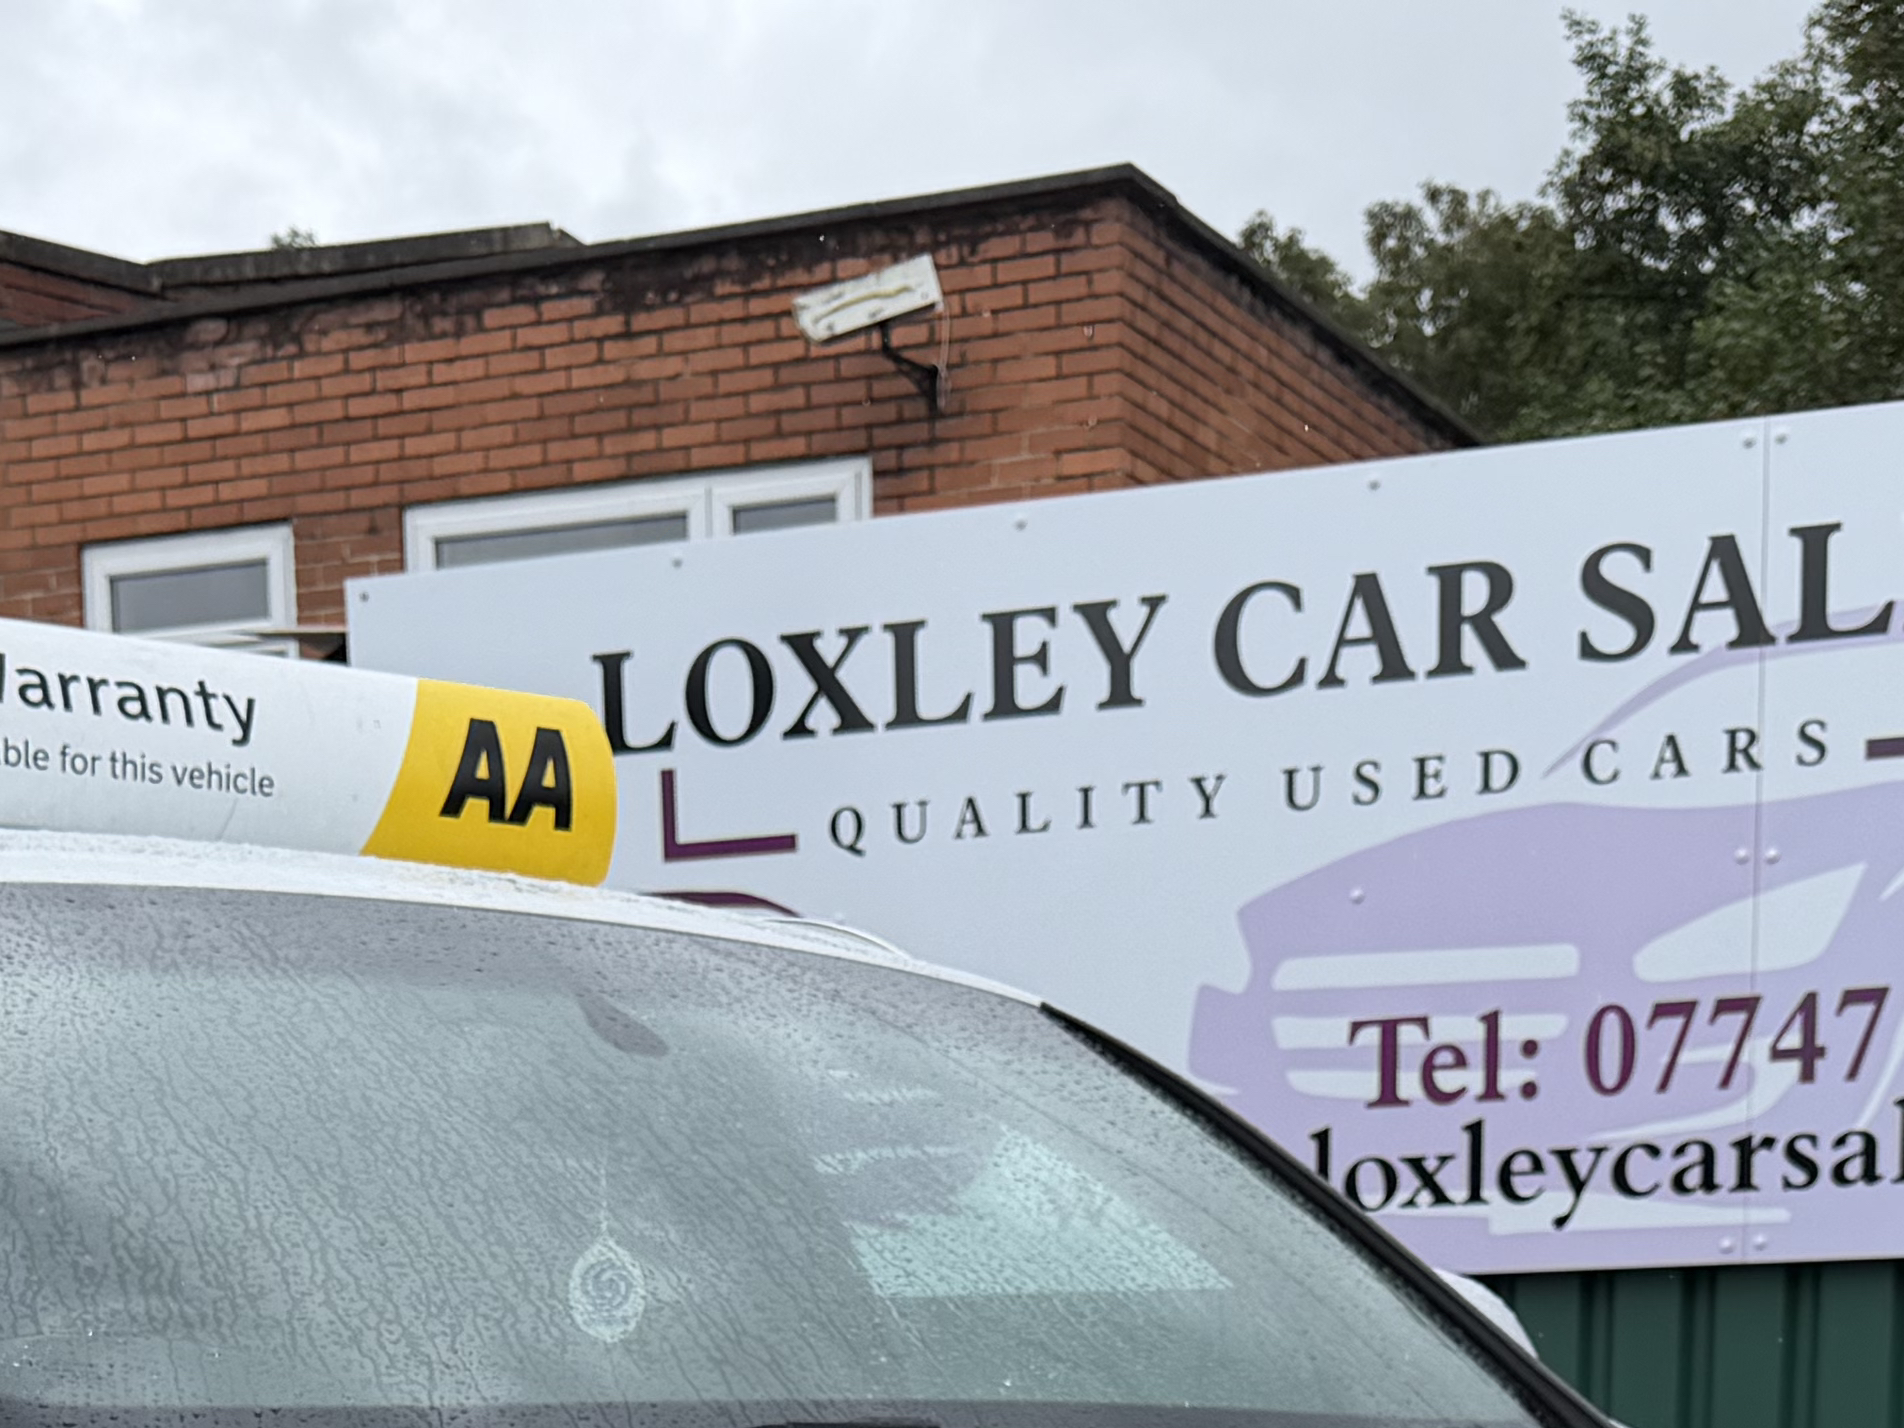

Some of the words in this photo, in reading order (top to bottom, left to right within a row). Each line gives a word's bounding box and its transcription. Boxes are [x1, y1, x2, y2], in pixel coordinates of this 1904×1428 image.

[592, 596, 1168, 757] LOXLEY
[1213, 560, 1527, 698] CAR
[60, 744, 102, 776] for
[110, 751, 163, 784] this
[172, 763, 275, 798] vehicle
[439, 717, 574, 832] AA
[829, 774, 1226, 857] QUALITY
[1283, 748, 1521, 811] USED
[1582, 719, 1830, 786] CARS
[1349, 1009, 1540, 1109] Tel:
[1584, 986, 1890, 1096] 07747
